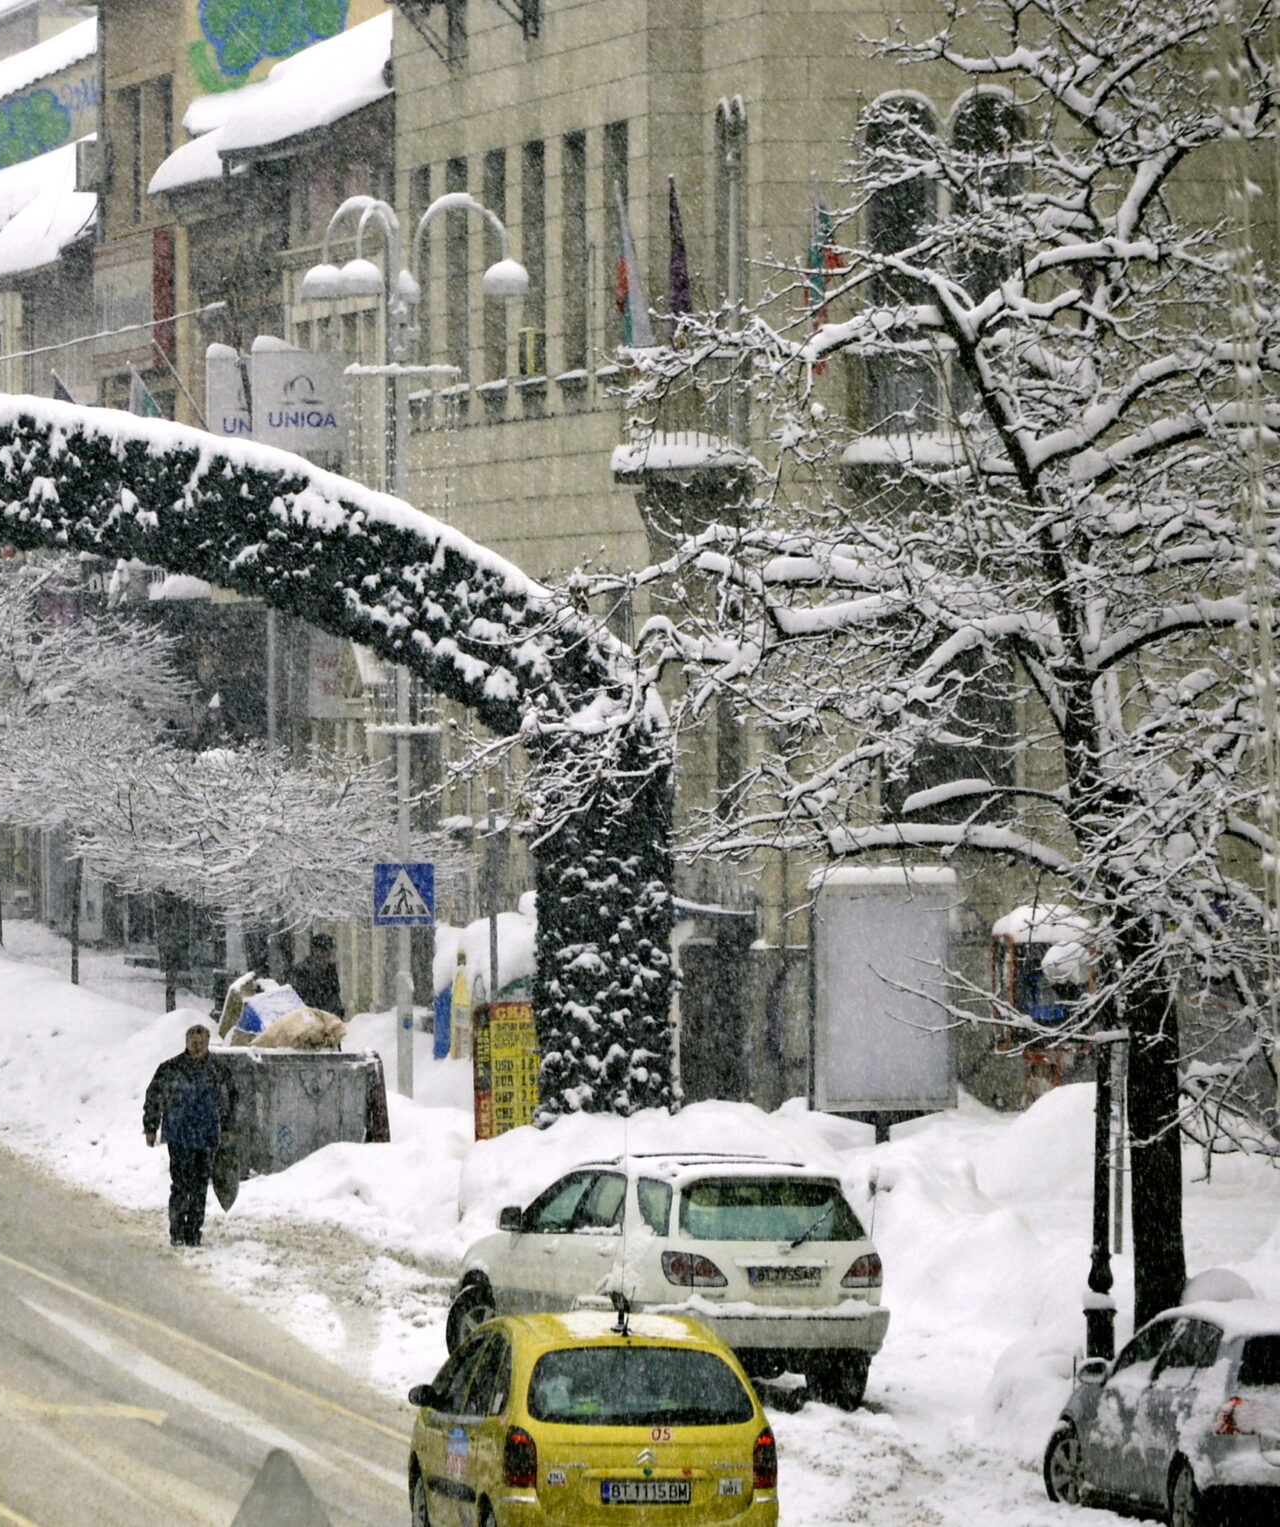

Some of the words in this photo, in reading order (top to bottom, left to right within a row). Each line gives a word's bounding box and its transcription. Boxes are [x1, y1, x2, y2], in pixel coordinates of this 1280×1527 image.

[269, 411, 338, 428] UNIQA
[494, 1060, 514, 1071] USD
[494, 1075, 514, 1087] EUR
[651, 1428, 671, 1441] 05
[634, 1484, 666, 1499] 1115
